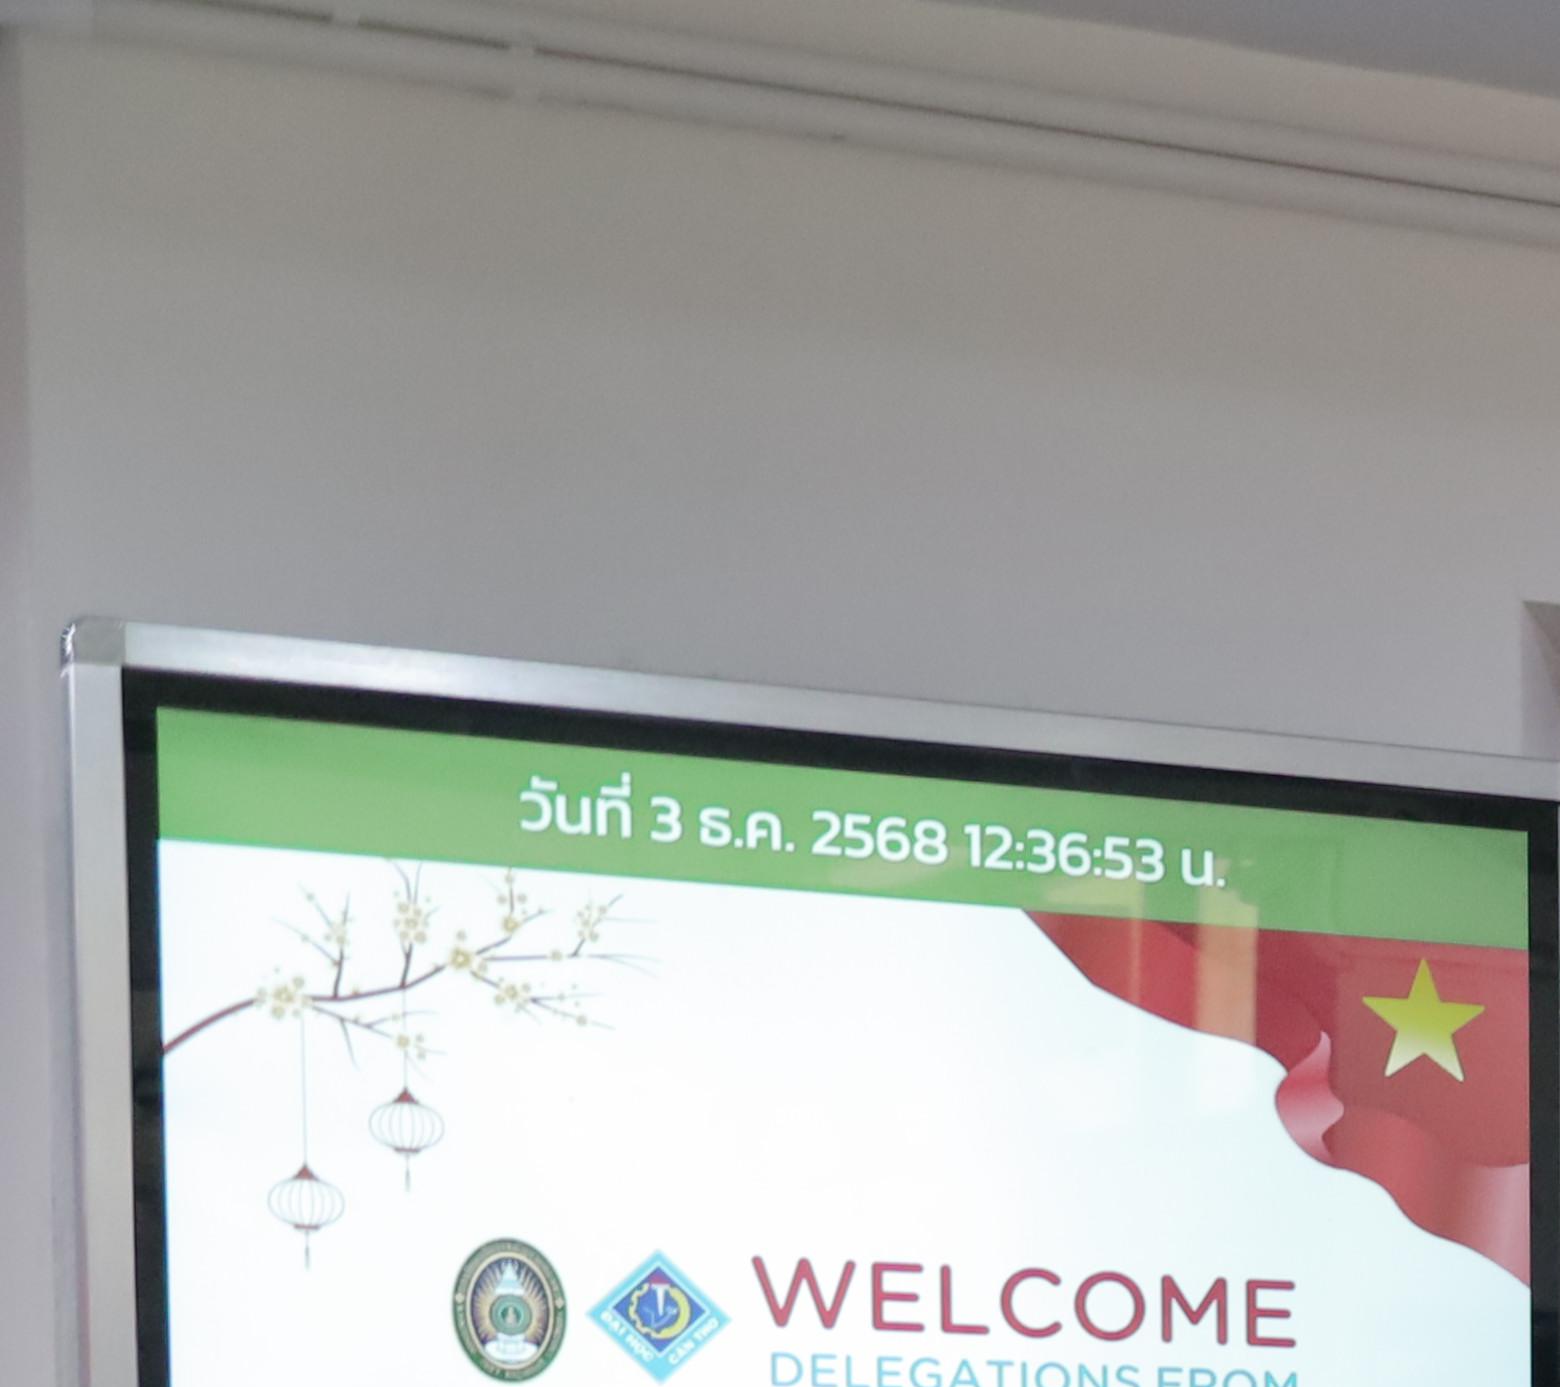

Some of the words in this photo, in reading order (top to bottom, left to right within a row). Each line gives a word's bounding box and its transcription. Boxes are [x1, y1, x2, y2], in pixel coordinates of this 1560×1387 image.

[519, 774, 631, 839] วันที่
[650, 796, 682, 842] 3
[700, 805, 794, 853] ธ.ค.
[811, 811, 949, 865] 2568
[964, 823, 1165, 884] 12:36:53
[1181, 849, 1227, 888] น.
[752, 1255, 1297, 1348] WELCOME
